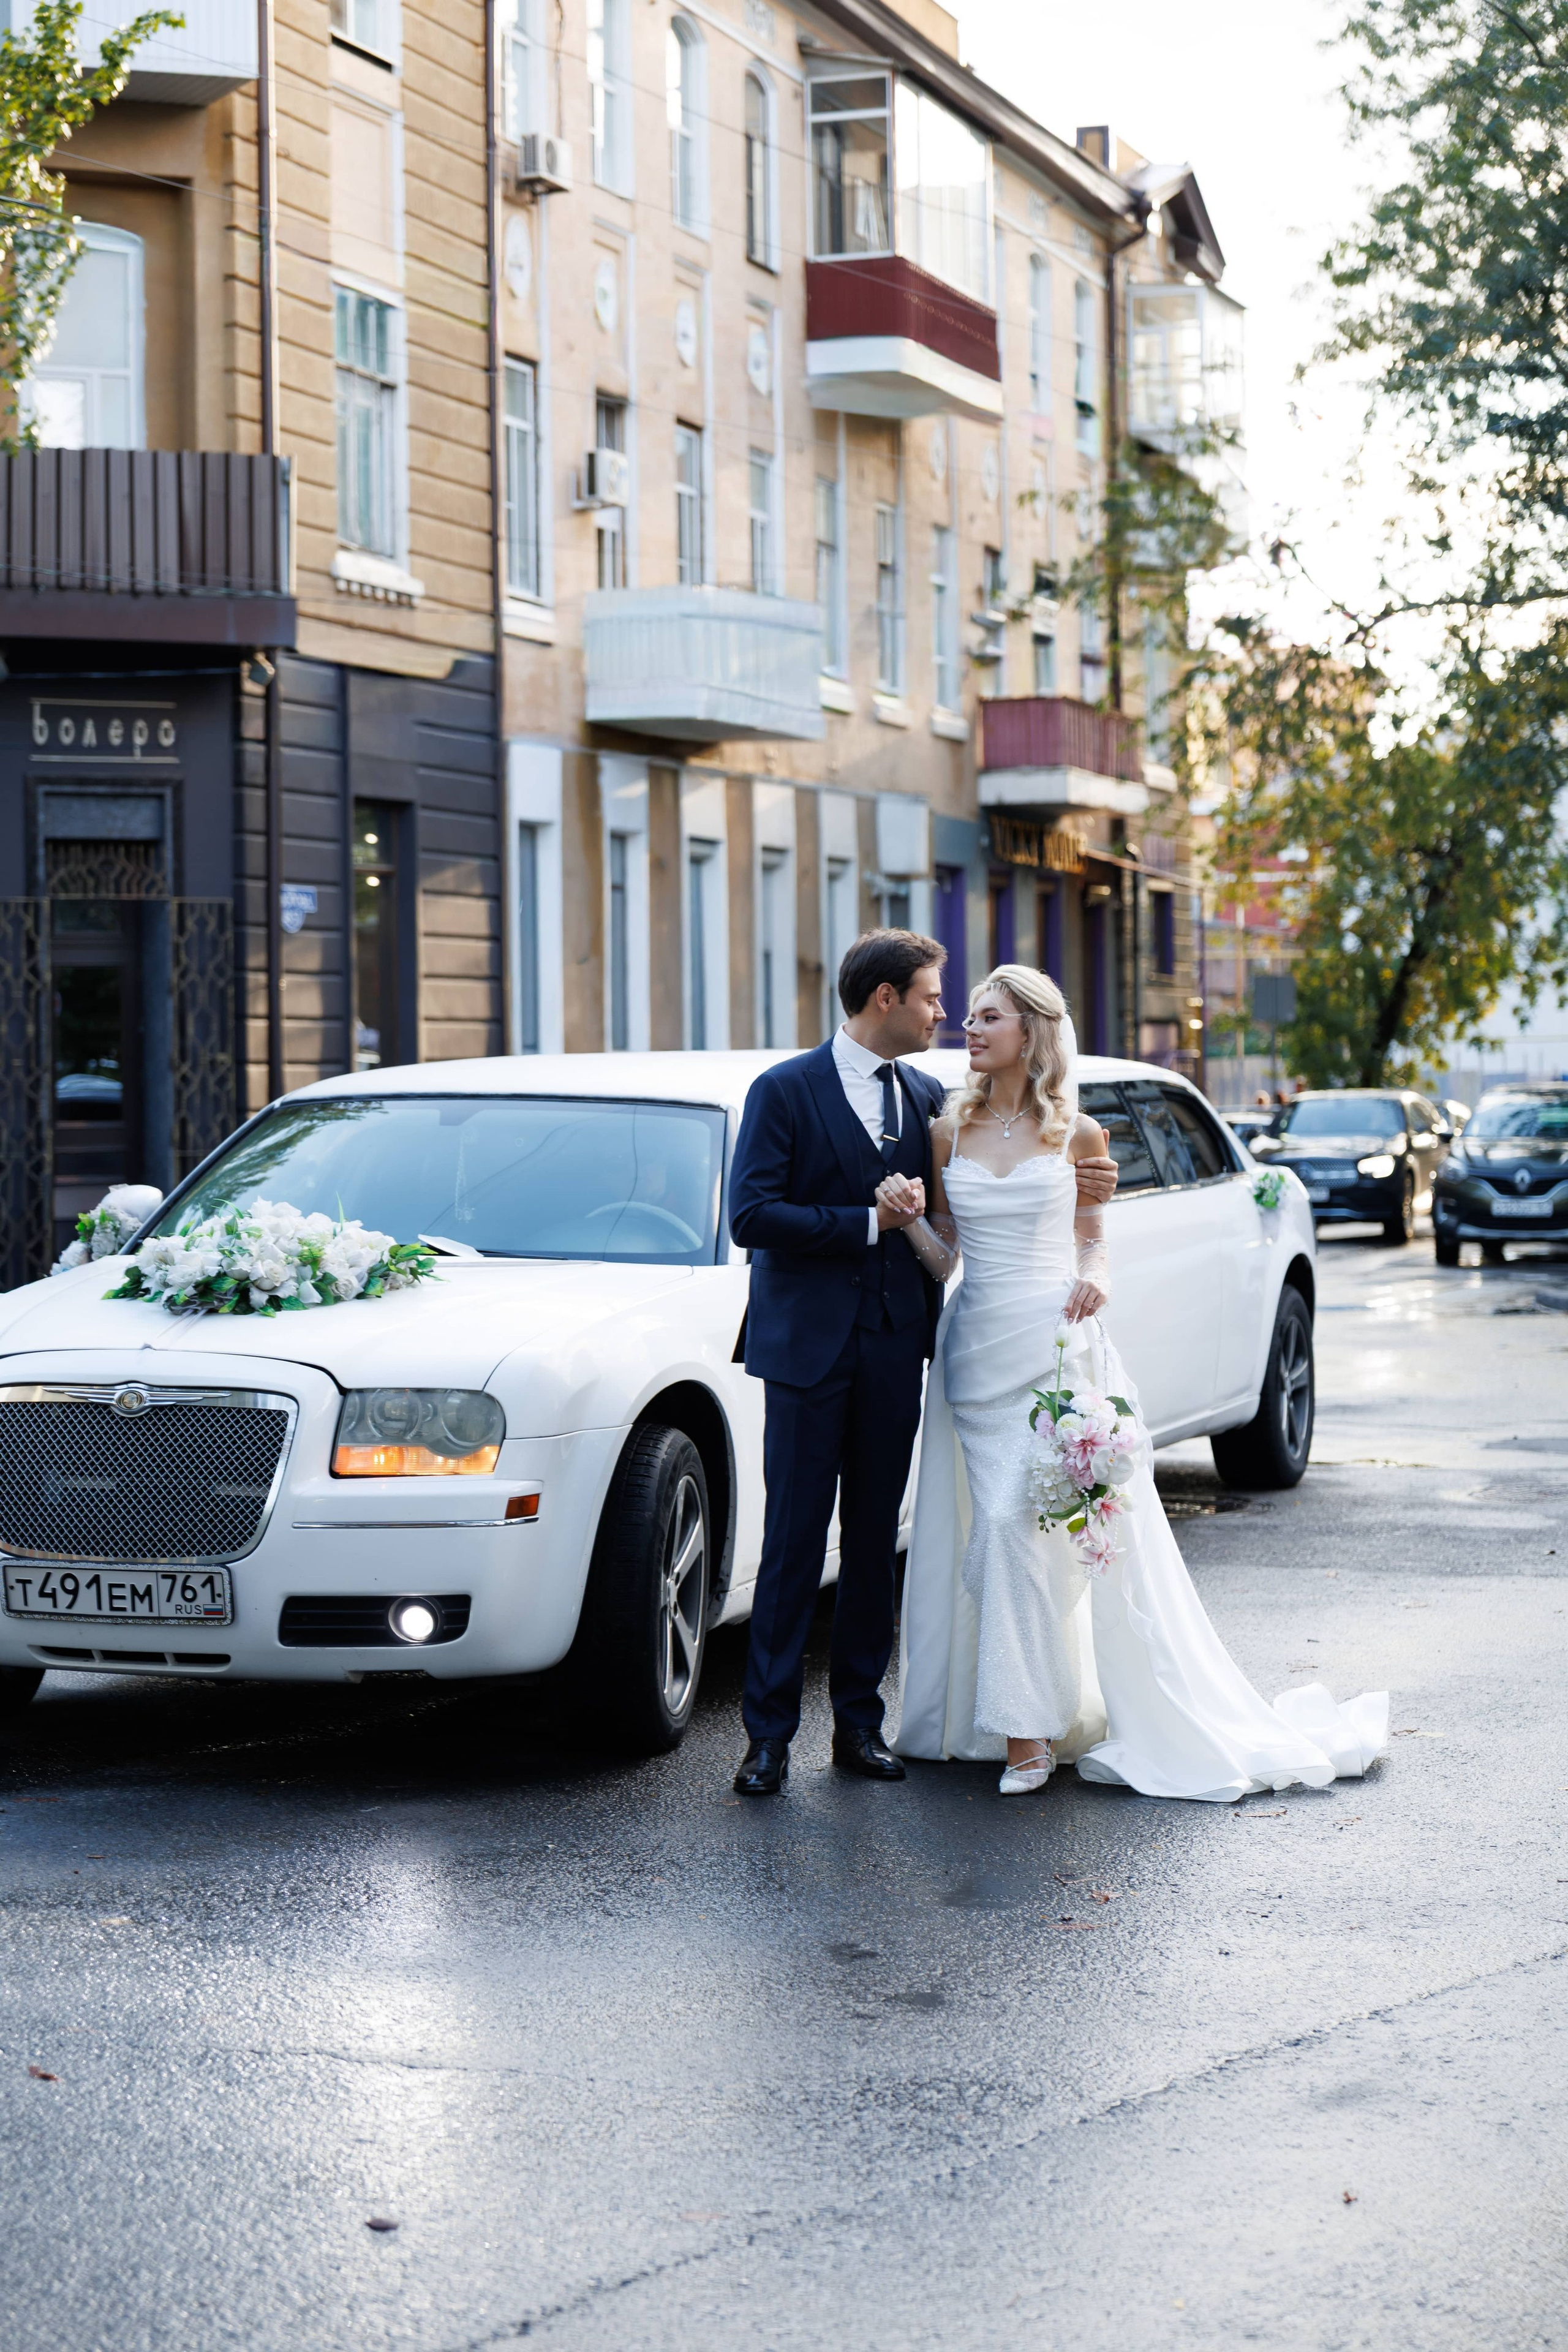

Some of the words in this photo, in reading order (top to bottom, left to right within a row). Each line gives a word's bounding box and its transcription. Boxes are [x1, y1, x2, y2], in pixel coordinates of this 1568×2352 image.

[15, 1571, 154, 1613] Т491ЕМ
[160, 1574, 217, 1604] 761
[175, 1604, 203, 1615] RUS
